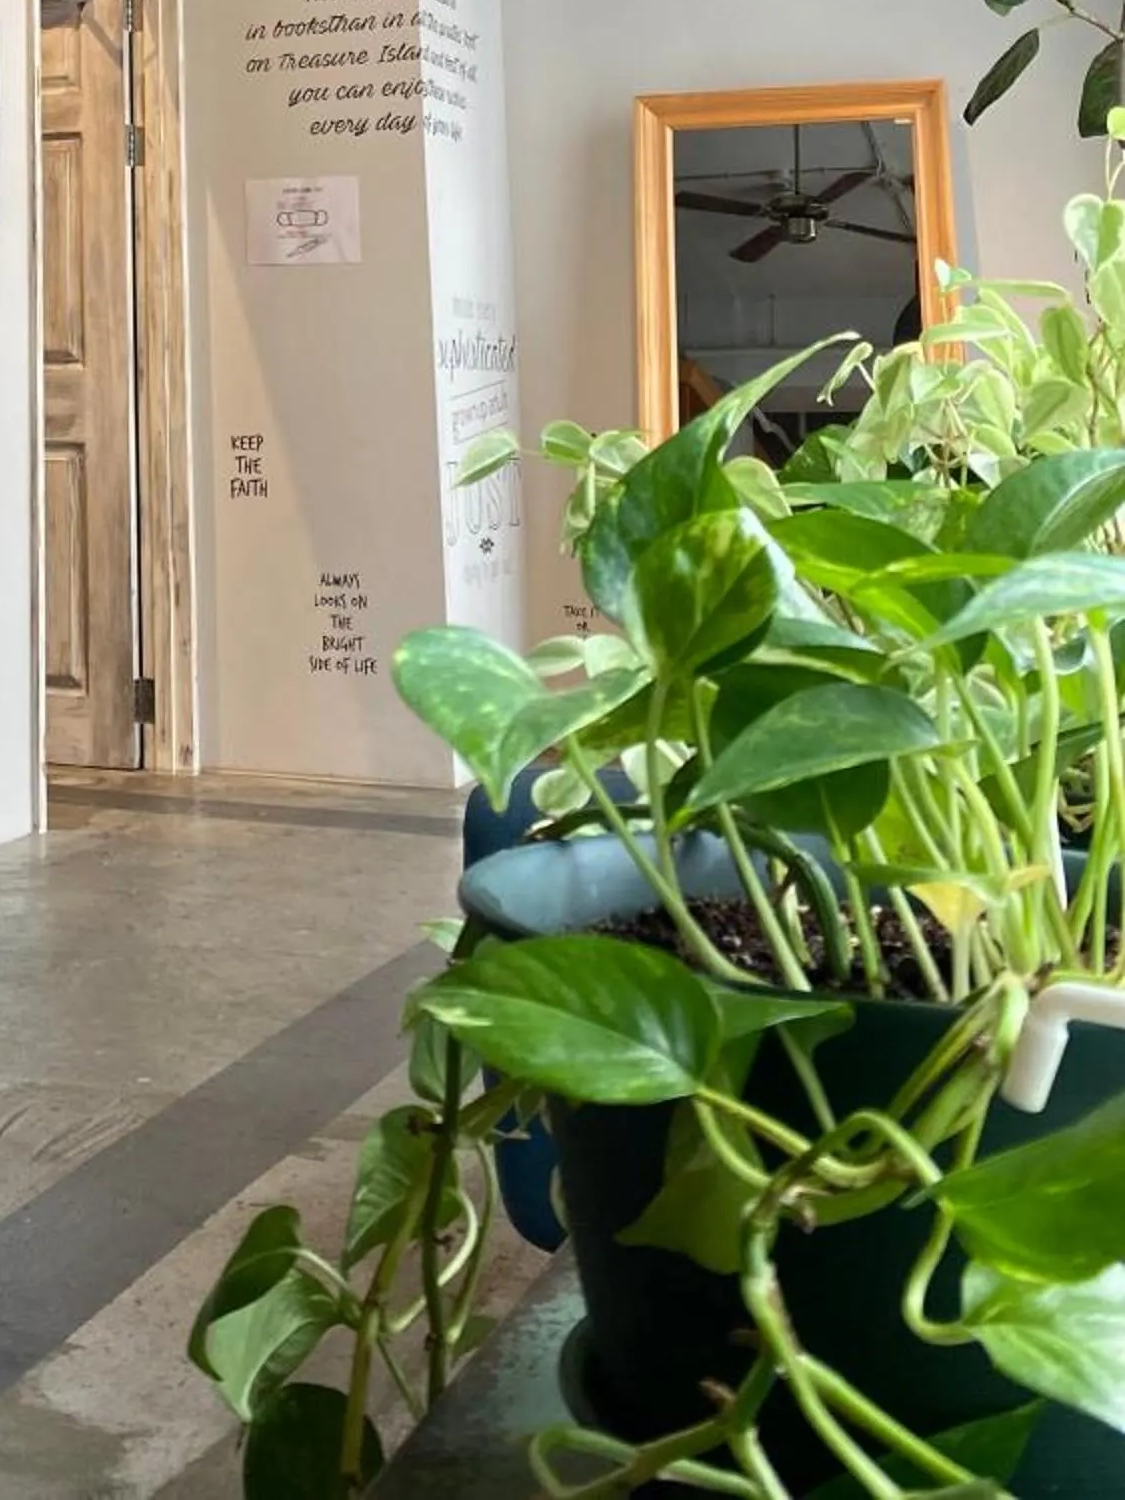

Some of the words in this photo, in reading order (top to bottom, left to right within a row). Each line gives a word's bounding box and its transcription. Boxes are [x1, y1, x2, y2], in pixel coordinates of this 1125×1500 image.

[245, 21, 266, 41] in
[382, 11, 404, 30] in
[246, 56, 272, 73] on
[278, 49, 369, 71] Treasure
[288, 86, 330, 107] you
[335, 81, 376, 100] can
[310, 114, 371, 137] every
[375, 112, 417, 135] day
[230, 433, 264, 452] KEEP
[234, 455, 262, 474] THE
[230, 478, 268, 499] FAITH
[320, 573, 361, 589] ALWAYS
[350, 595, 368, 609] ON
[330, 614, 353, 631] THE
[322, 635, 365, 652] BRIGHT
[309, 655, 331, 673] SIDE
[336, 658, 350, 674] OF
[354, 658, 378, 675] LIFE
